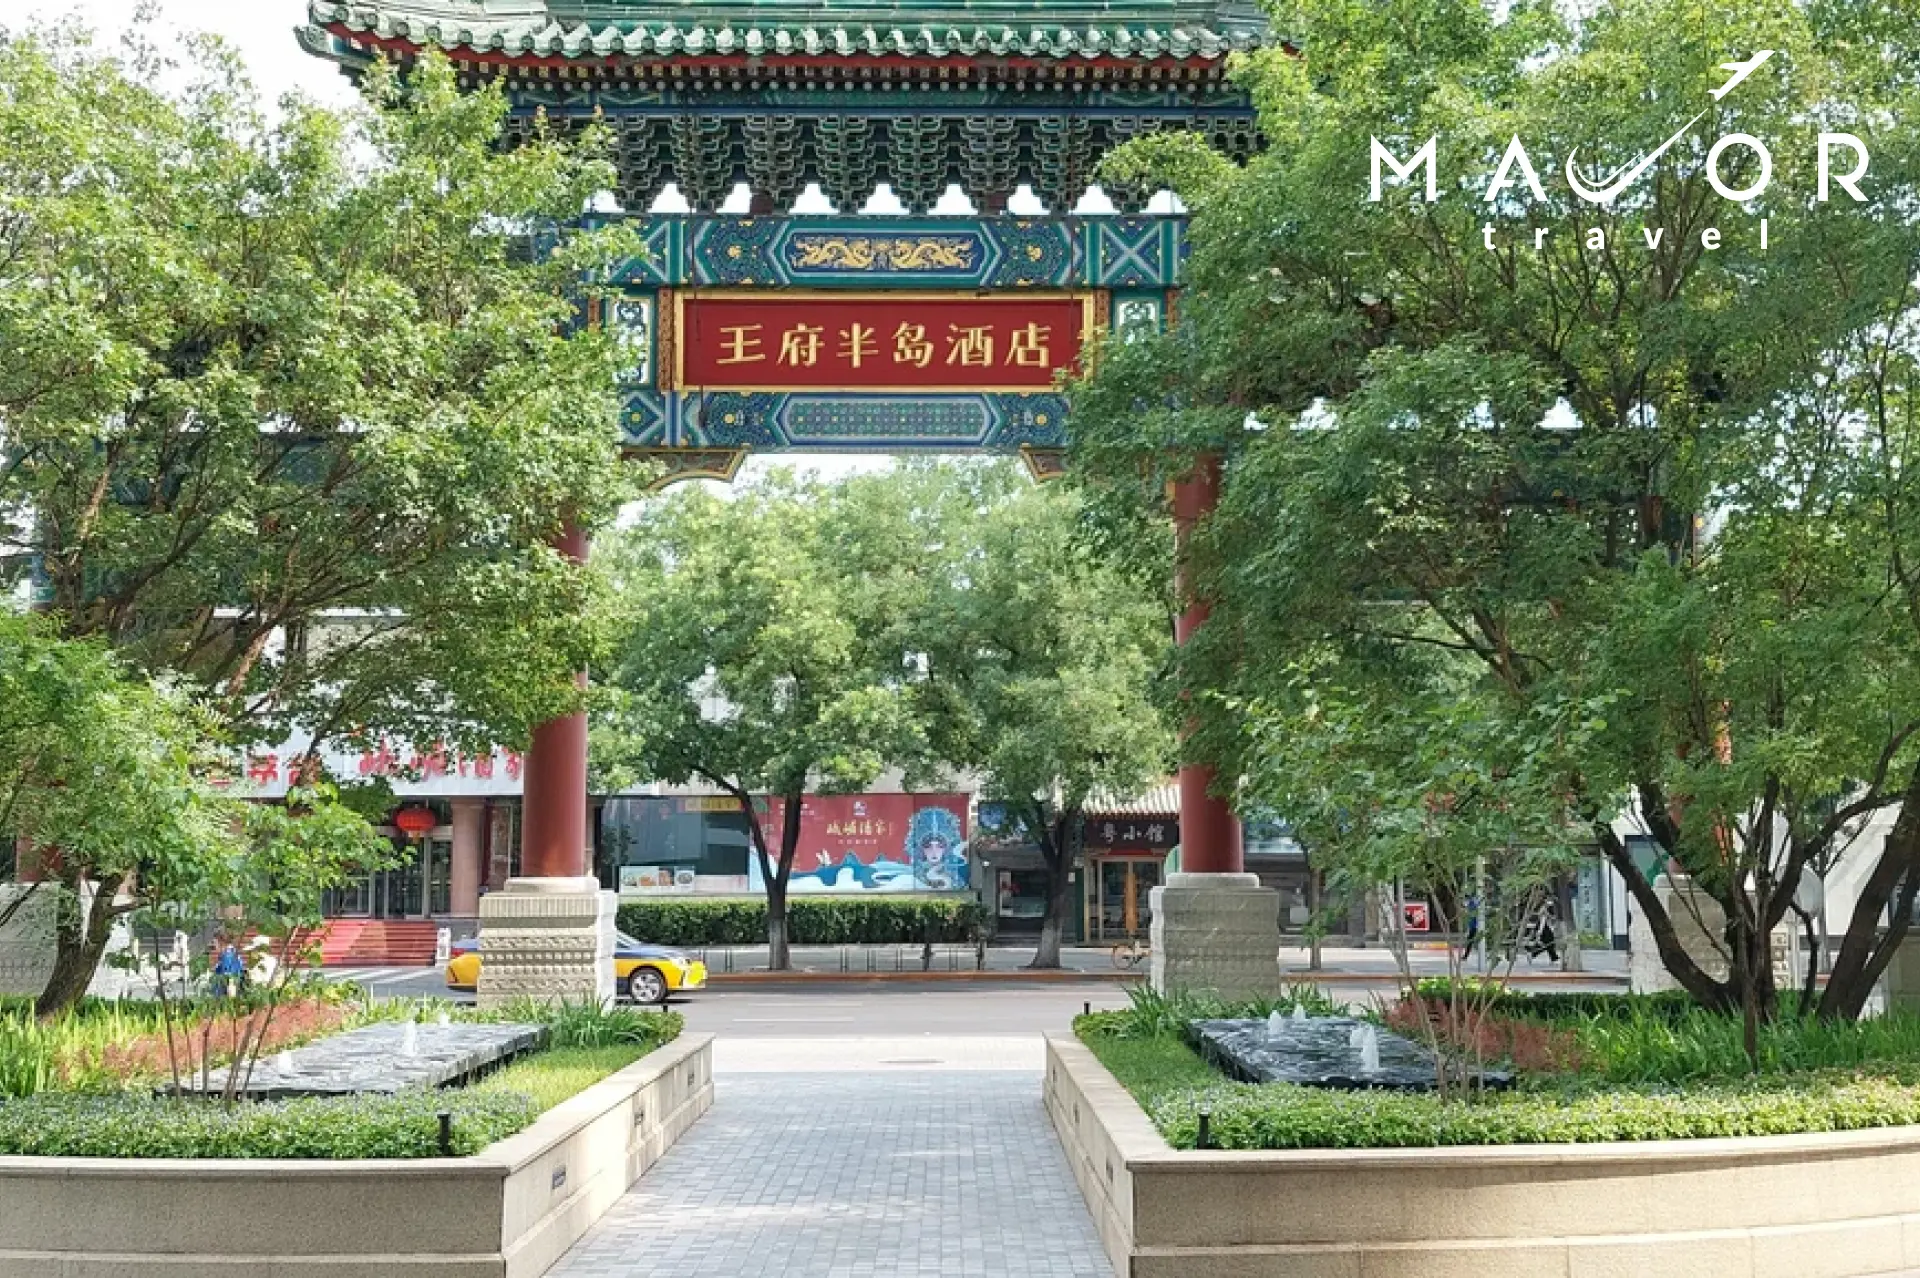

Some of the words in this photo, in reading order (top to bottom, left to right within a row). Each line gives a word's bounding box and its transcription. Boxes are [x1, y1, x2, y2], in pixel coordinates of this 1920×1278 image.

[715, 321, 1052, 369] 王府半岛酒店
[1100, 822, 1164, 844] 粤小馆
